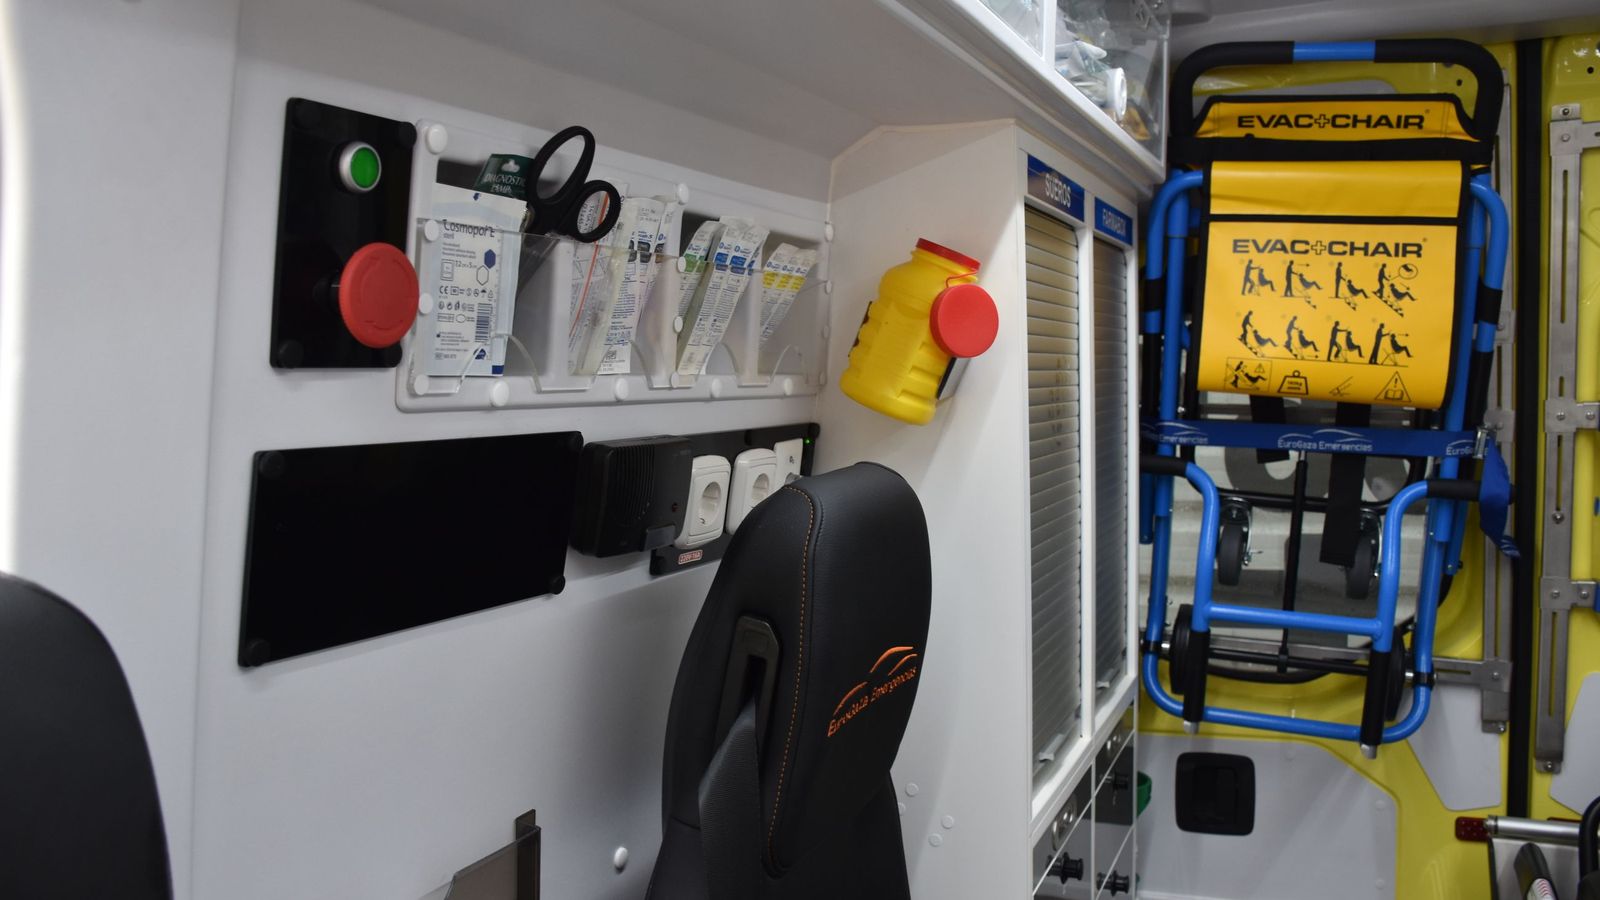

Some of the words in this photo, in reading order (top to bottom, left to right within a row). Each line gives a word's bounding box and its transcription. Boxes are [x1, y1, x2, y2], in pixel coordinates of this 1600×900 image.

[1045, 173, 1071, 208] SUEROS
[1277, 439, 1317, 449] EuroGaza
[1319, 441, 1372, 452] Emergencias
